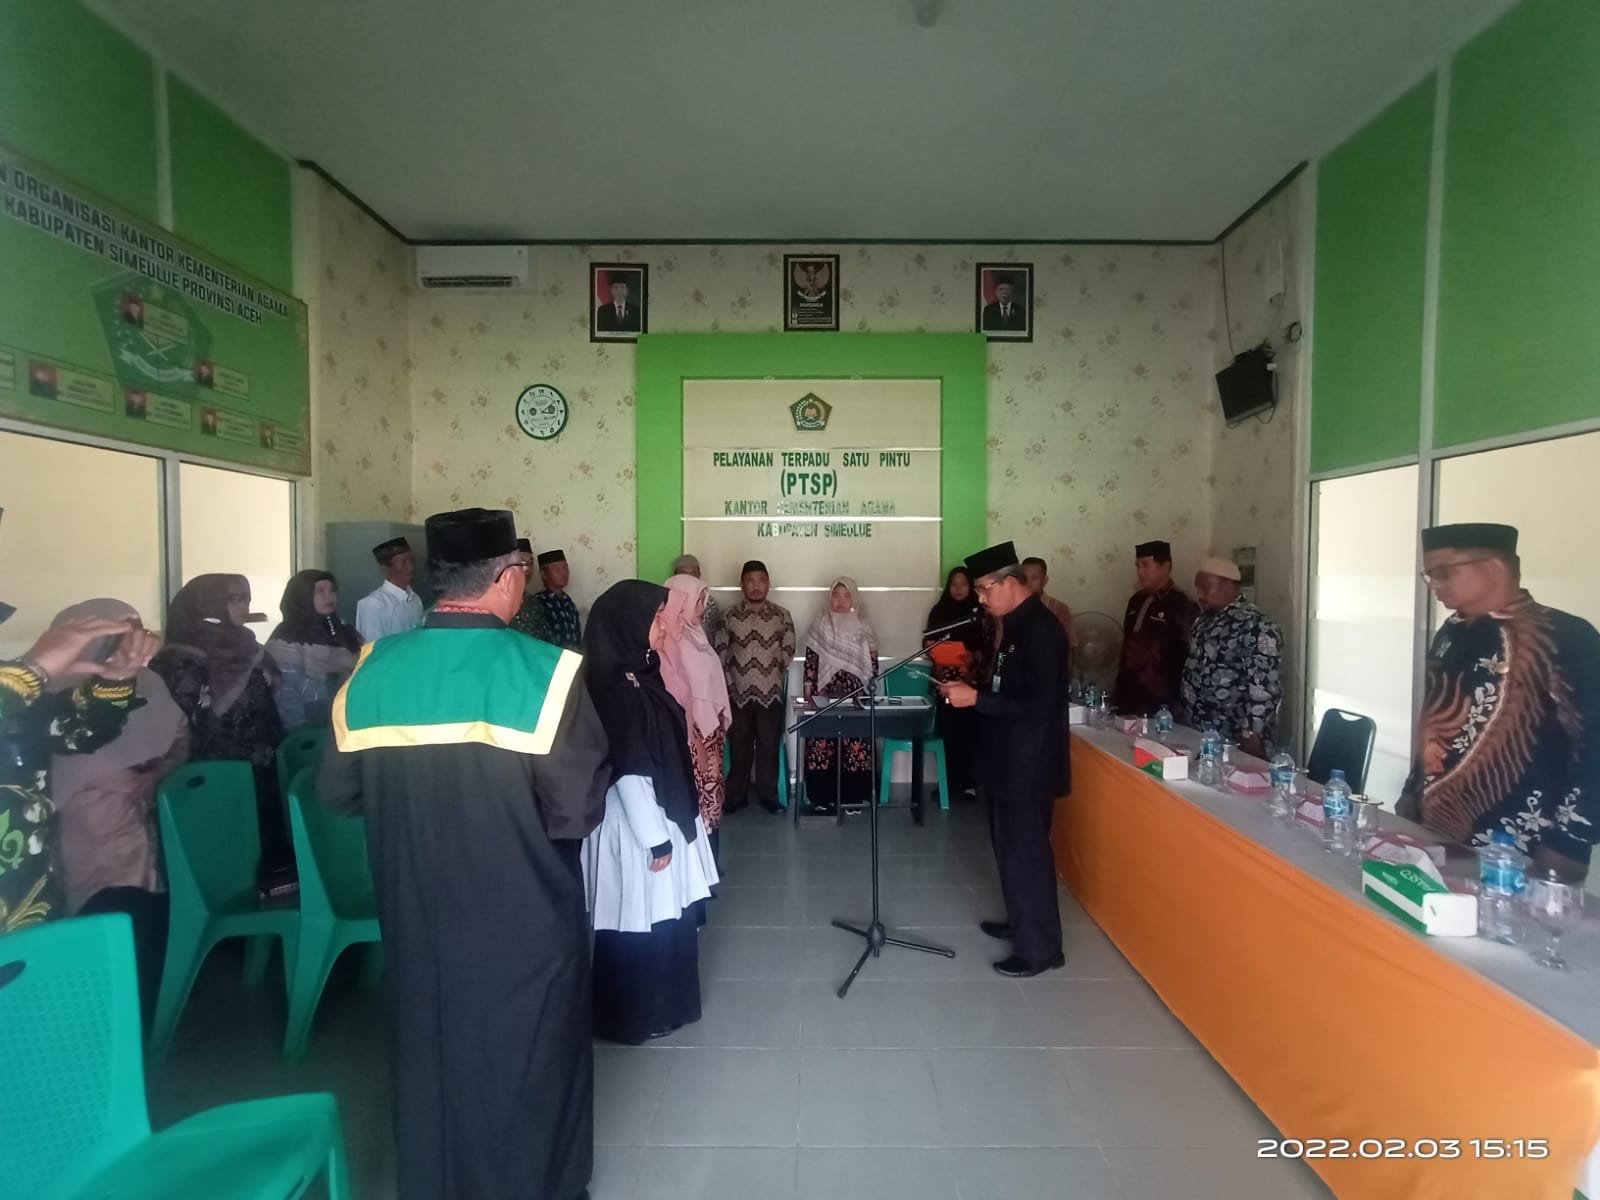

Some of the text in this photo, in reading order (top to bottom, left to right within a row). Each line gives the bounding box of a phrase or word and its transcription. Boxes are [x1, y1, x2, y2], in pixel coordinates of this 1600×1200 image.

[14, 170, 116, 236] ORGANISASI
[121, 223, 174, 264] KANTOR
[178, 252, 254, 303] KEMENTERIAN
[257, 292, 288, 317] AGAMA
[4, 192, 262, 326] KABUPATEN SIMEULUE PROVINSI ACEH
[713, 452, 911, 467] PELAYANAN TERPADU SATU PINTU
[780, 469, 838, 498] (PTSP)
[724, 500, 768, 515] KANTOR
[757, 522, 818, 538] KABUPATEN
